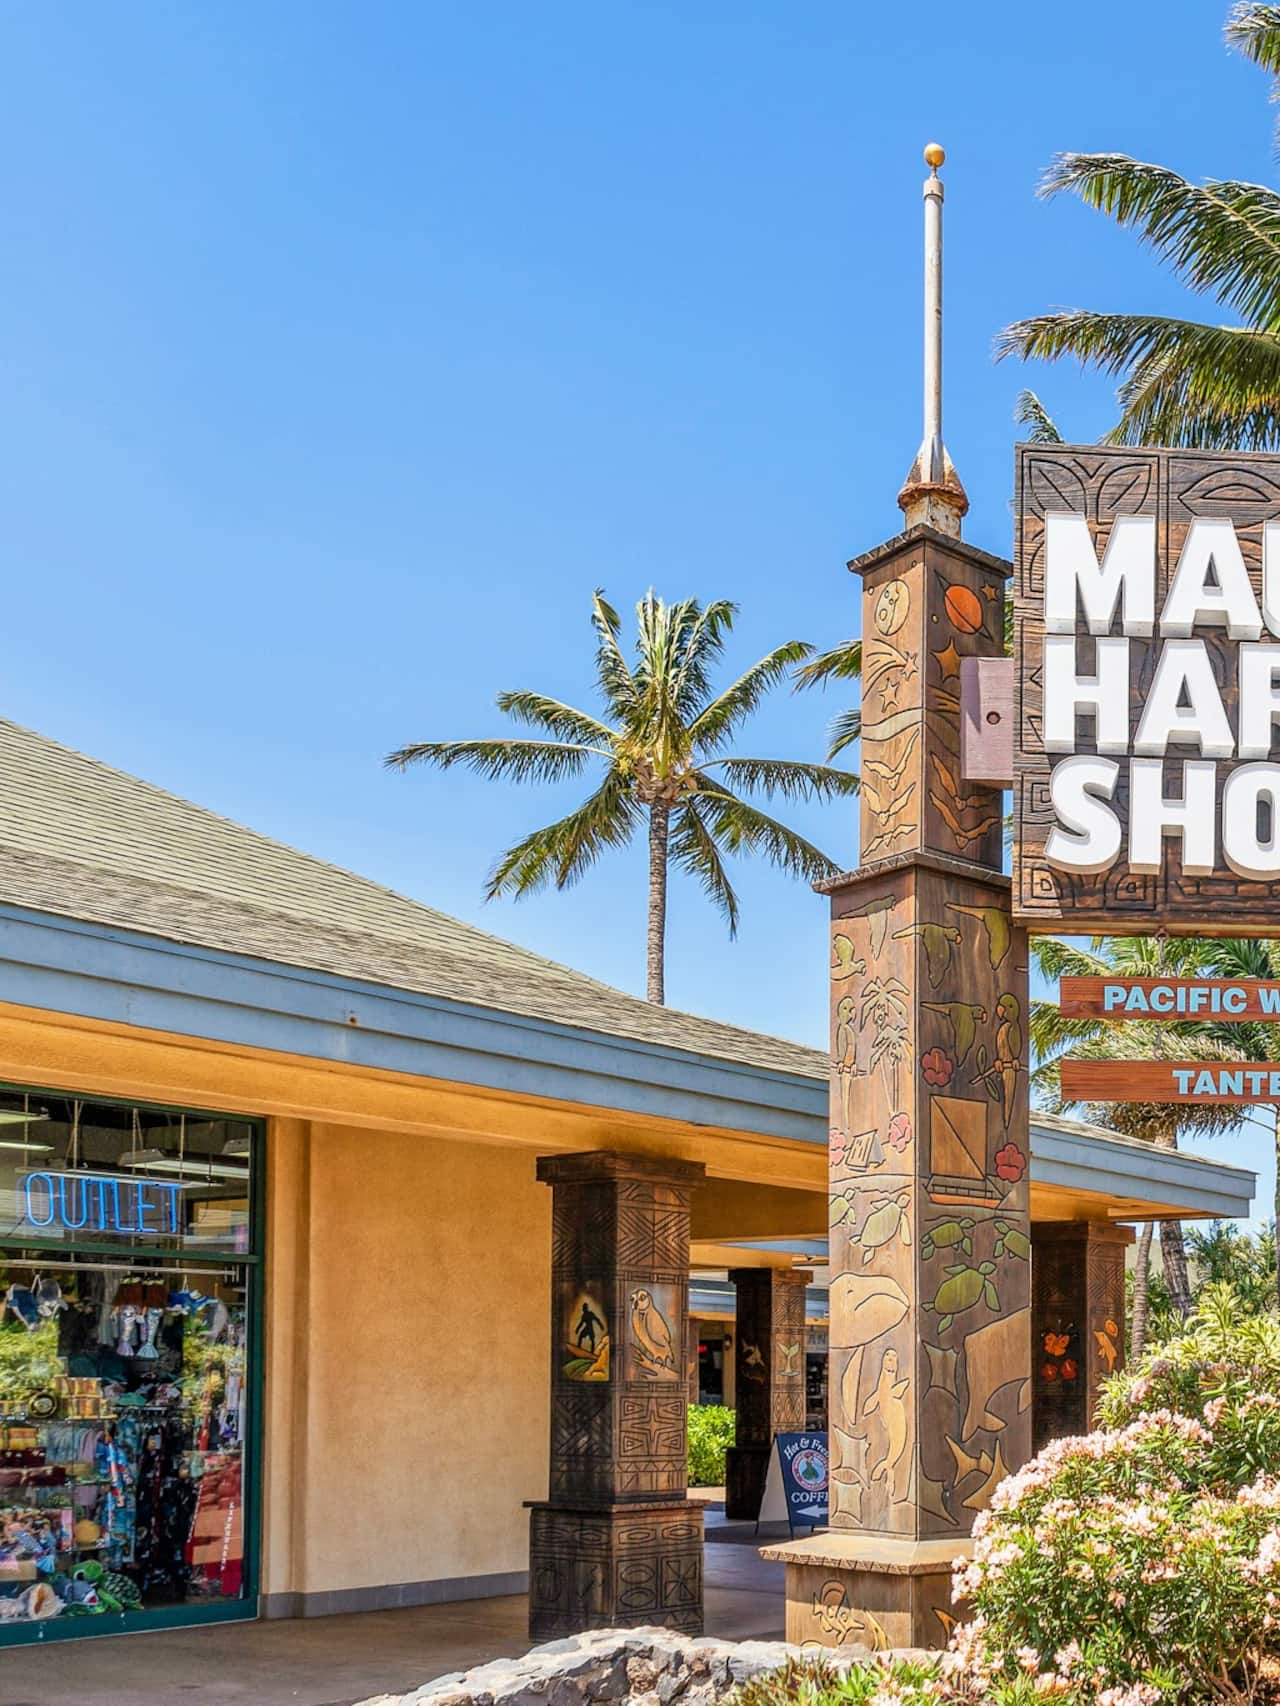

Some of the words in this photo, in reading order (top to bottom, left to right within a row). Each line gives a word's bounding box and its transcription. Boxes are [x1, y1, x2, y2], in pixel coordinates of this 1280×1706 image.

[1103, 985, 1247, 1014] PACIFIC
[25, 1172, 183, 1233] OUTLET
[783, 1442, 800, 1460] Hot
